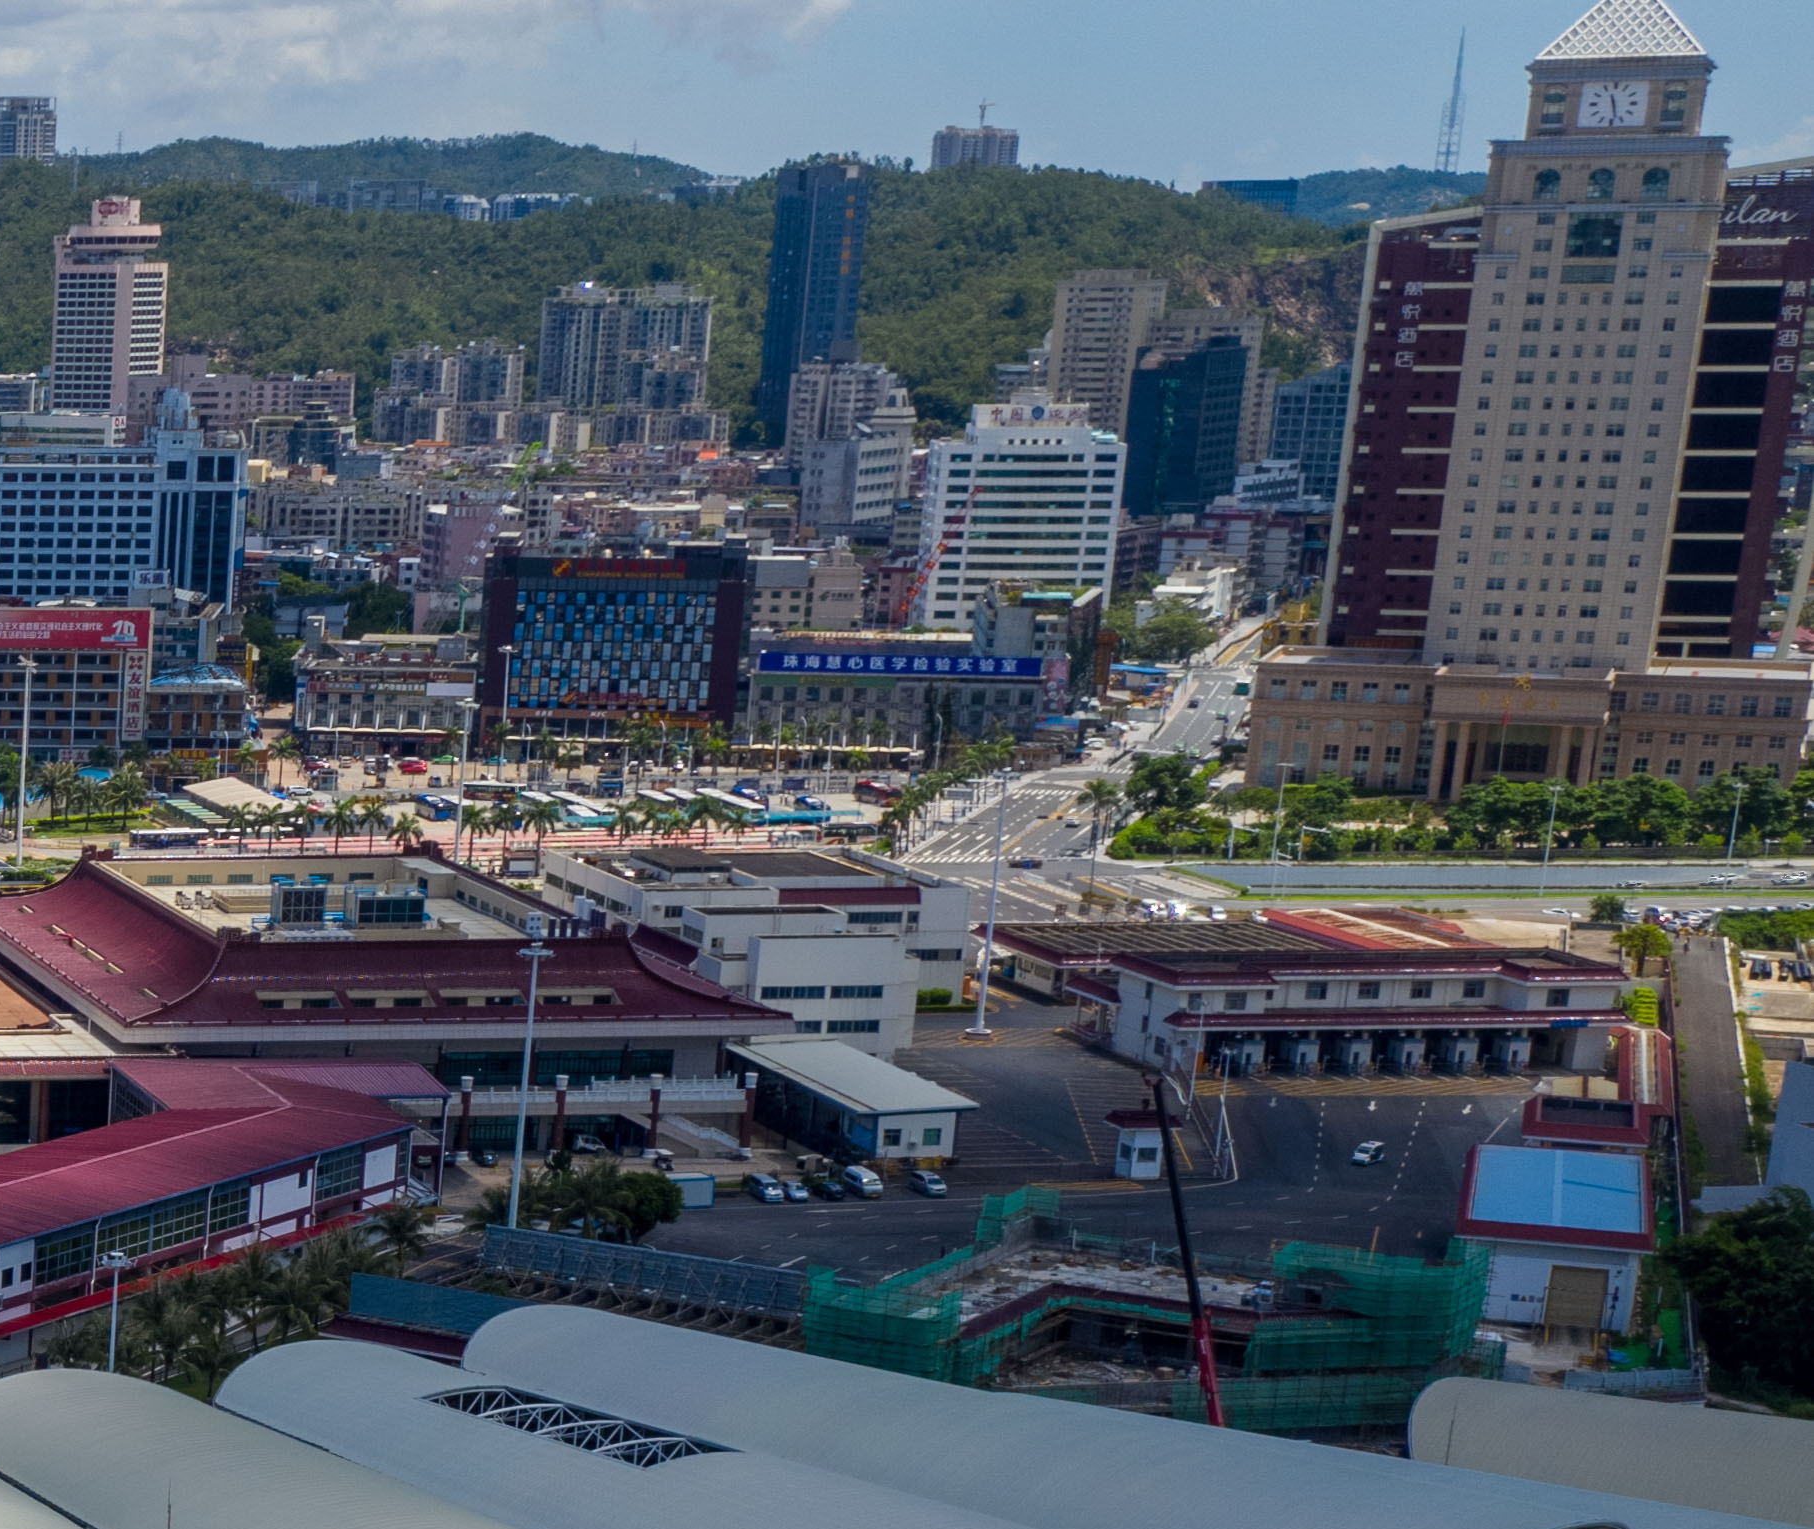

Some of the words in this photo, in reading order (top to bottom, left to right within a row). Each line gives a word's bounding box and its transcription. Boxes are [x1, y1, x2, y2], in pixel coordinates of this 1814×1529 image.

[1718, 194, 1797, 224] ilan
[782, 655, 1018, 673] 珠海慧心医学检验实验室
